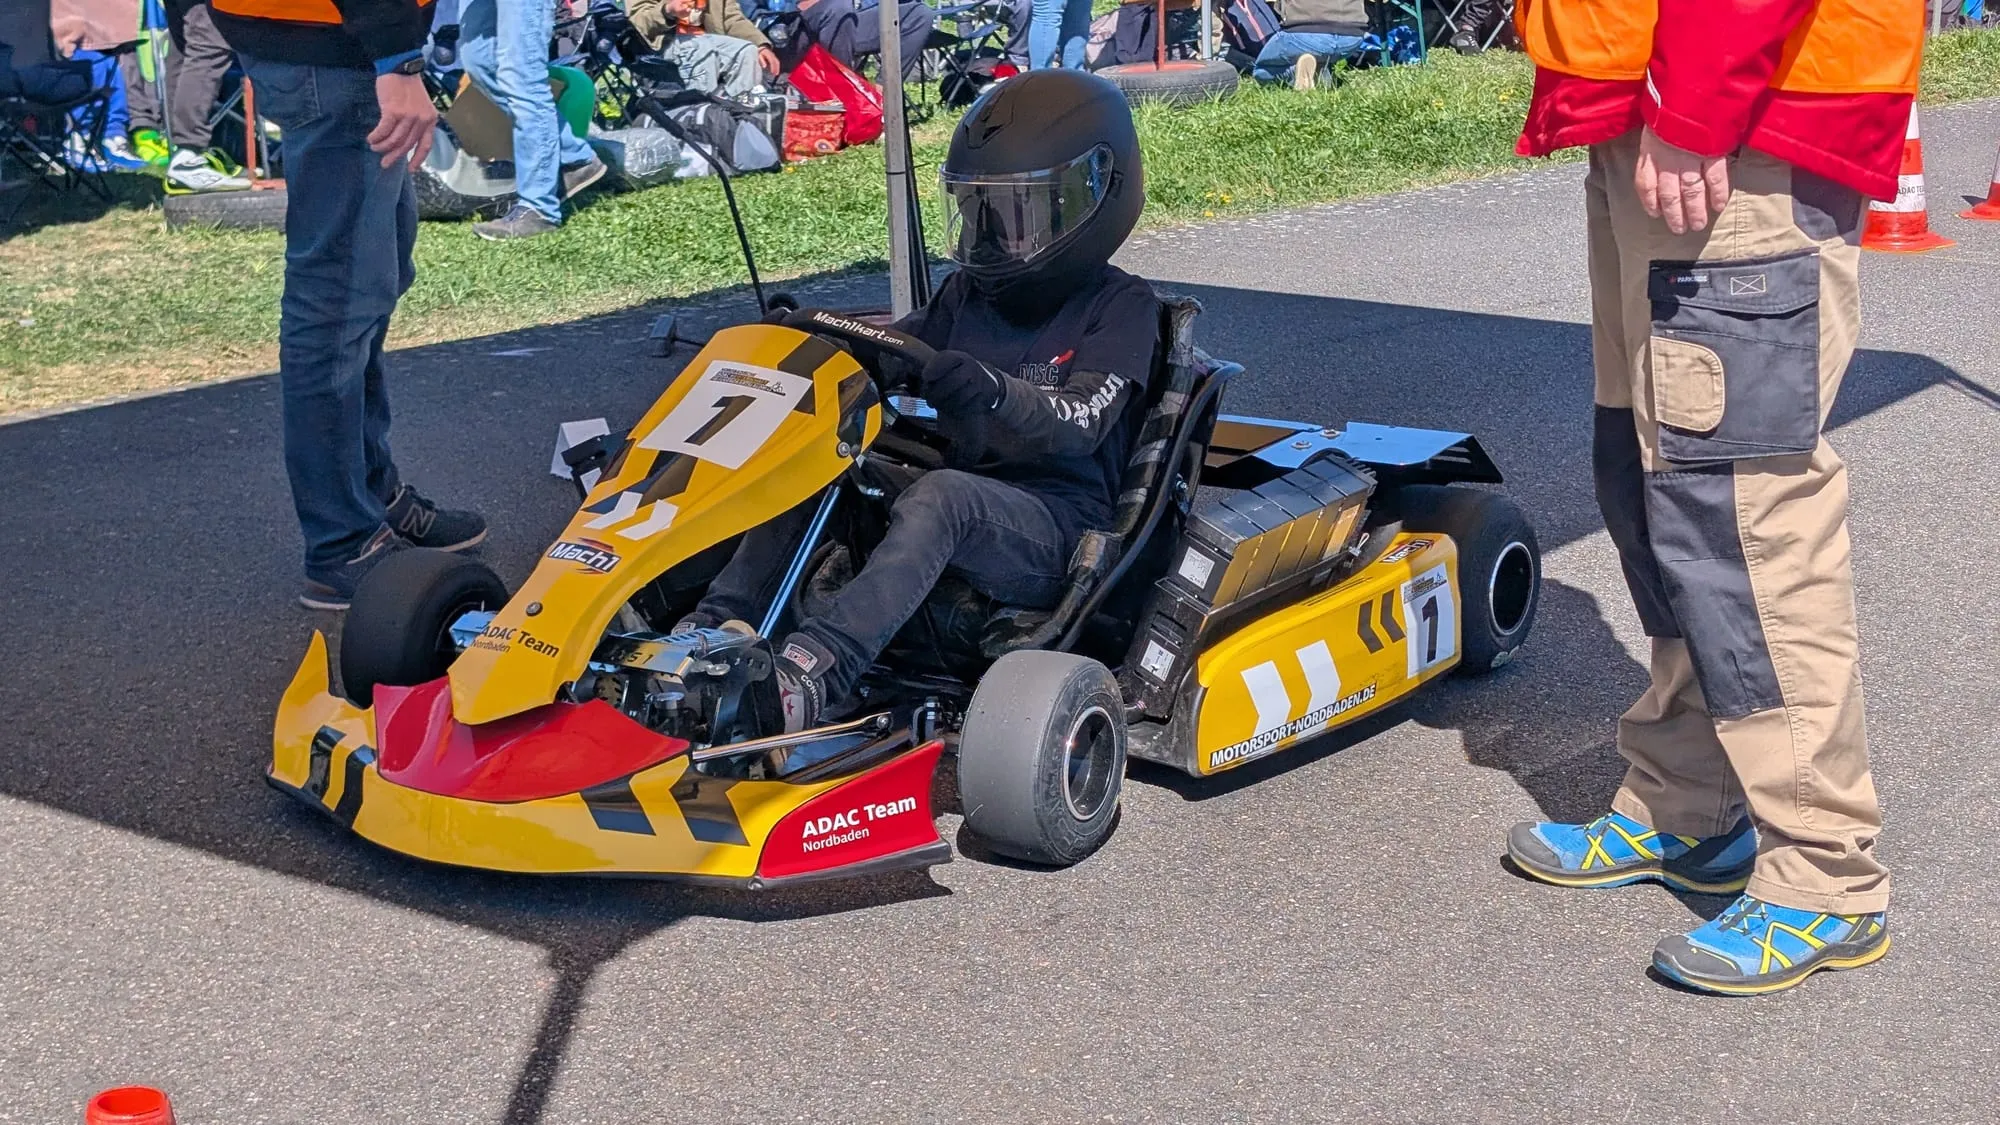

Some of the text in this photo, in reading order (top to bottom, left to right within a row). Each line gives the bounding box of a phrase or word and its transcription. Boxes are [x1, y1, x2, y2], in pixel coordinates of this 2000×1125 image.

[1677, 275, 1708, 283] PARK
[1019, 363, 1059, 385] MSC
[683, 394, 757, 447] 1
[548, 542, 620, 571] Mach1
[482, 625, 560, 659] ADAC Team
[1421, 594, 1439, 664] 1
[1211, 684, 1377, 767] MOTORSPORT-NORDBADEN.DE
[802, 796, 917, 839] ADAC Team
[803, 827, 870, 853] Nordbaden
